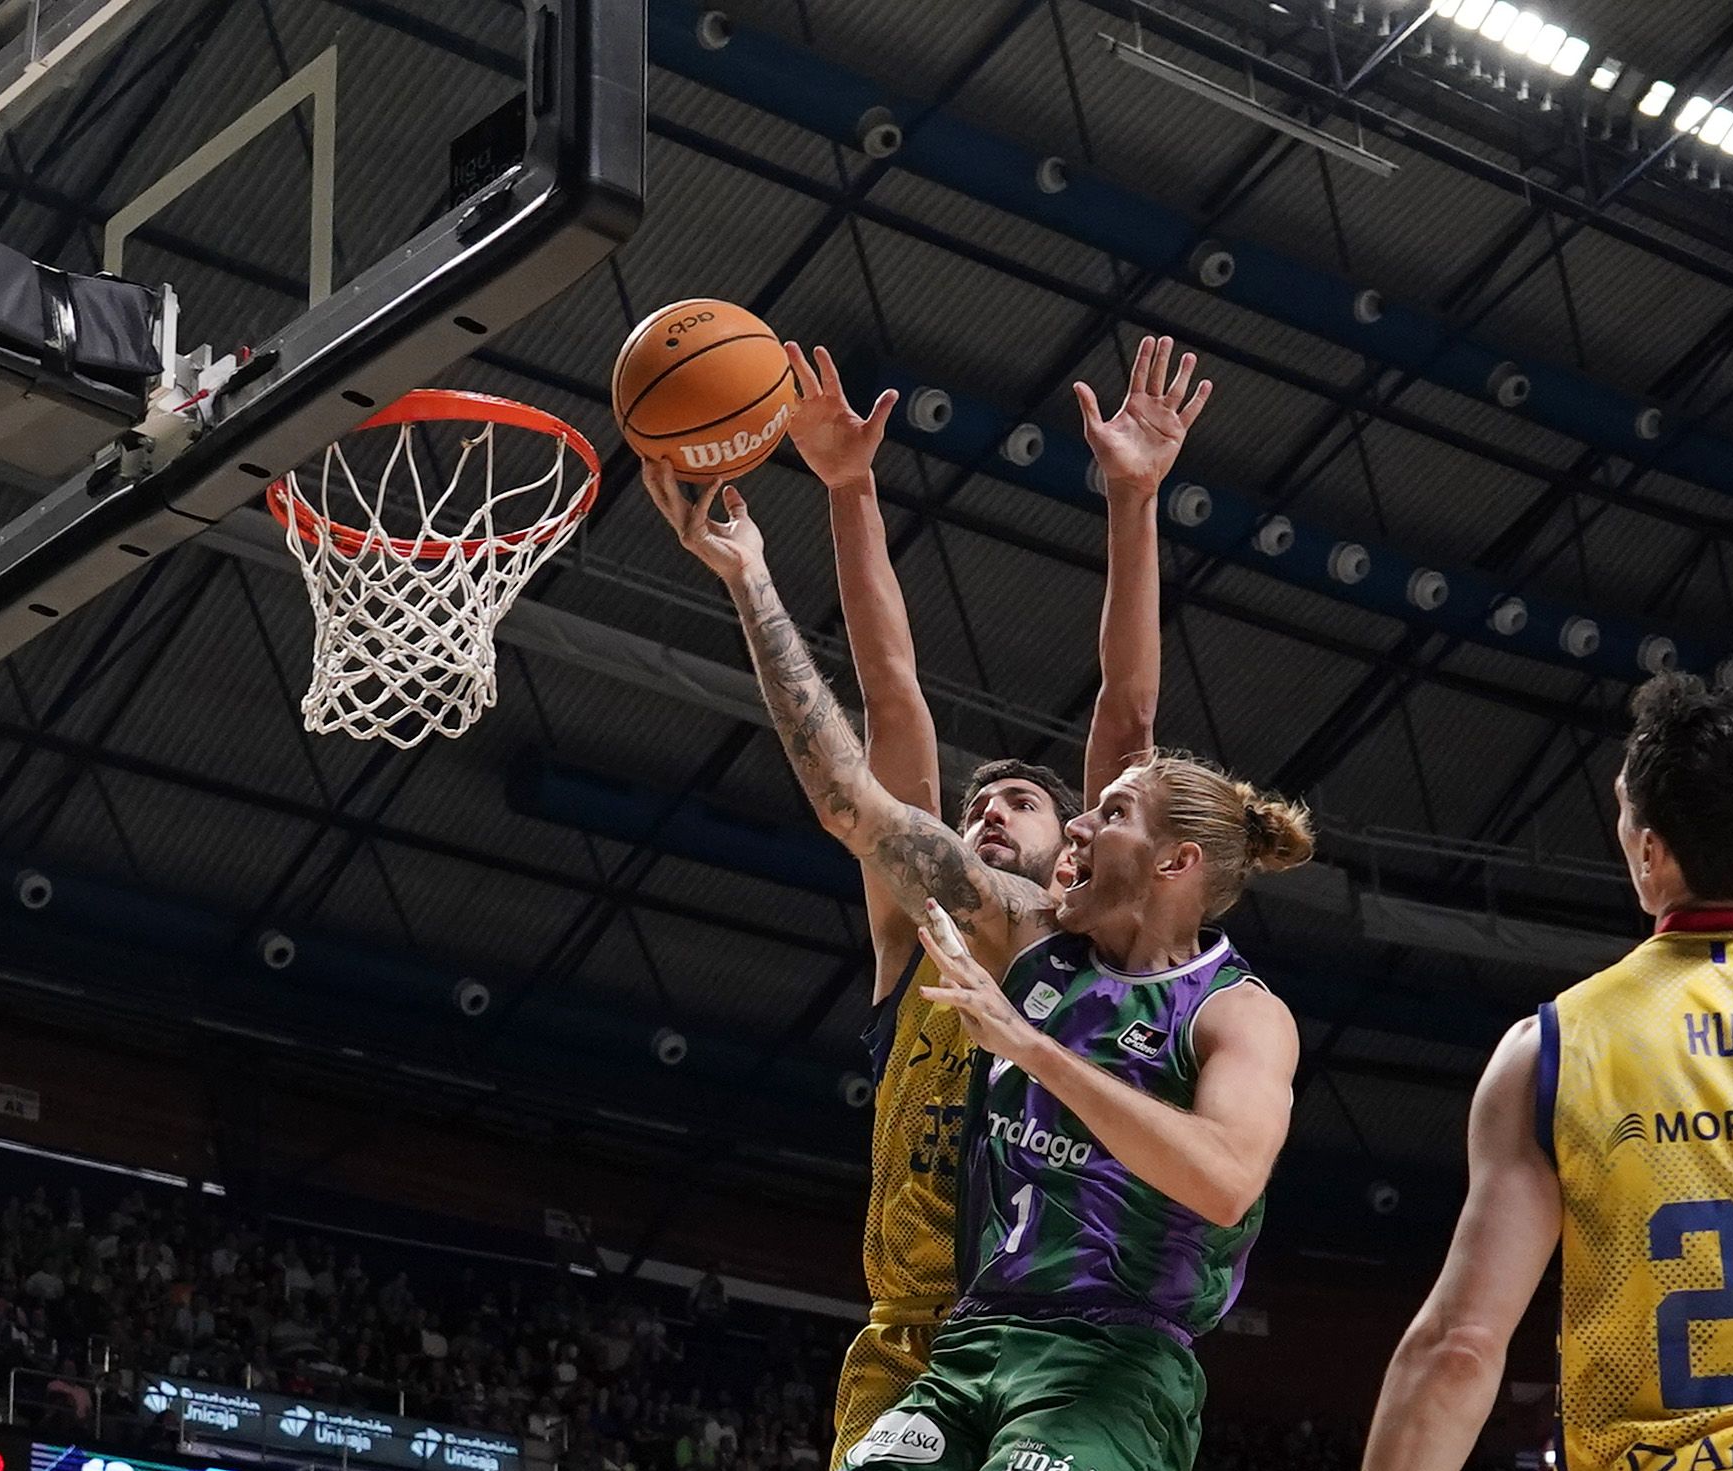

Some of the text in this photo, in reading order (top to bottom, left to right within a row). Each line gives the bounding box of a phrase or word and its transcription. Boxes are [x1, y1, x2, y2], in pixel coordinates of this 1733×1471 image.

[679, 404, 788, 468] Wilson
[988, 1108, 1093, 1168] málaga
[1006, 1184, 1034, 1253] 1
[1016, 1438, 1045, 1453] sabor
